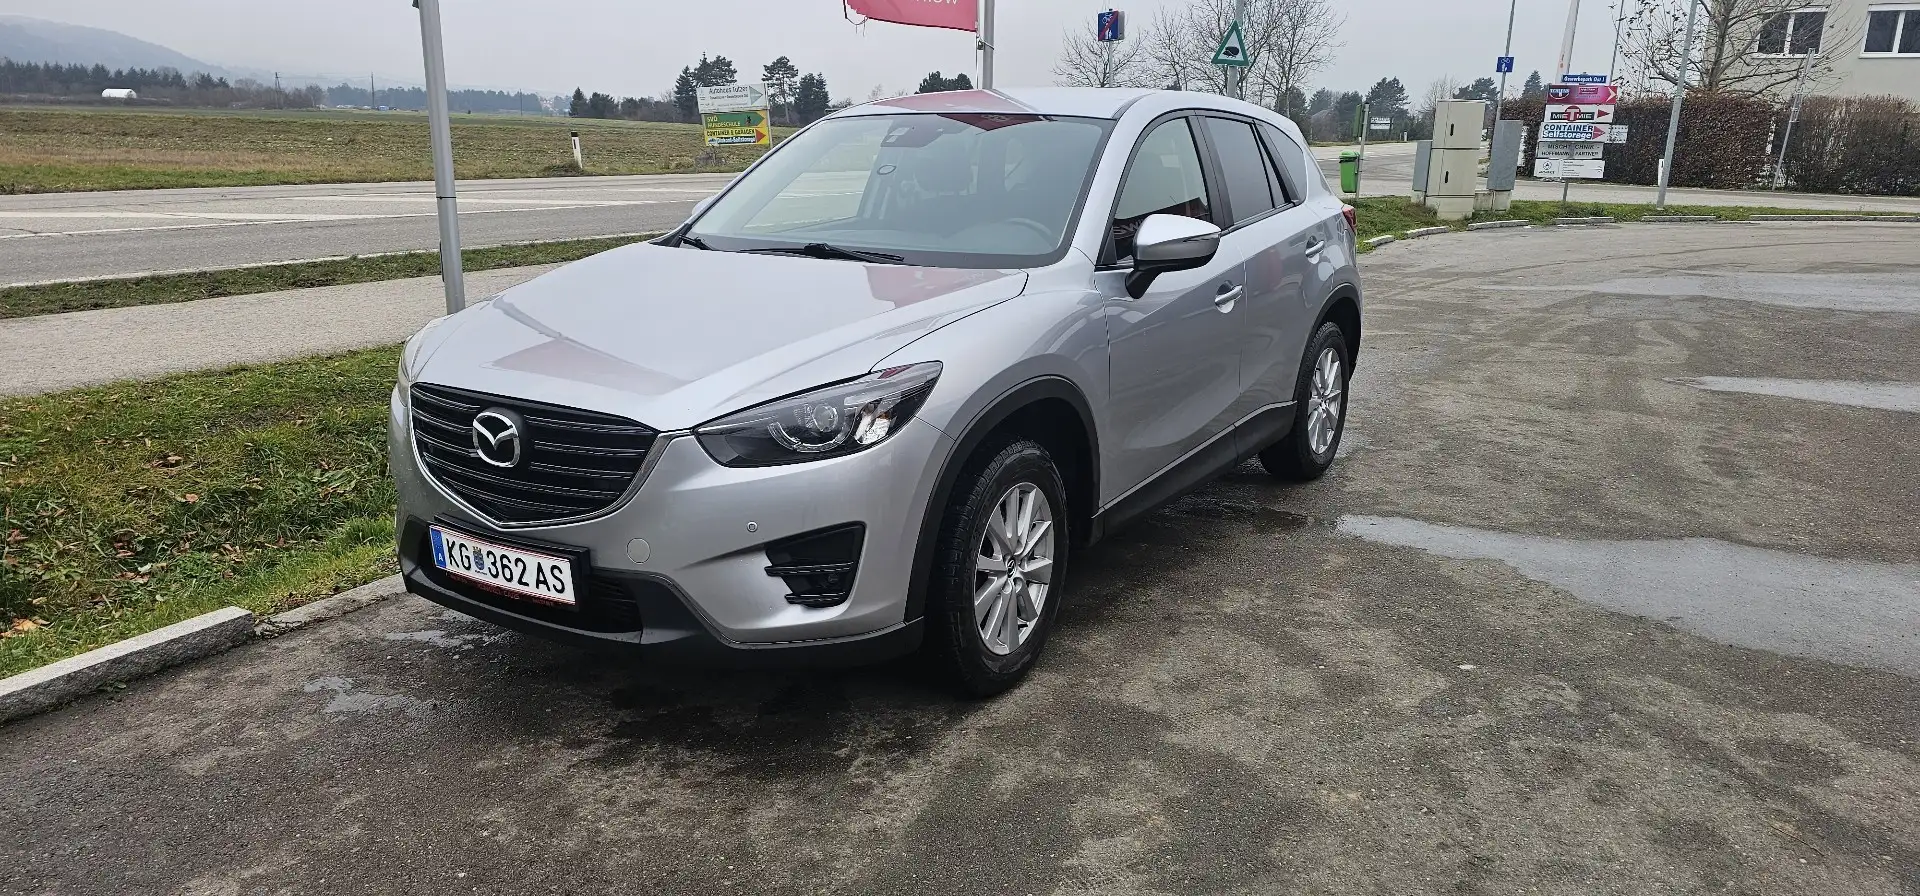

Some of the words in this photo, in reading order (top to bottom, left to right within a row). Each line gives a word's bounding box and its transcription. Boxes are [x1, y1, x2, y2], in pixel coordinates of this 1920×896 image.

[1543, 124, 1593, 132] CONTAINER
[1543, 131, 1592, 139] Selfstorage
[438, 554, 443, 562] A
[446, 538, 472, 571] KG
[486, 550, 530, 587] 362
[535, 561, 566, 594] AS
